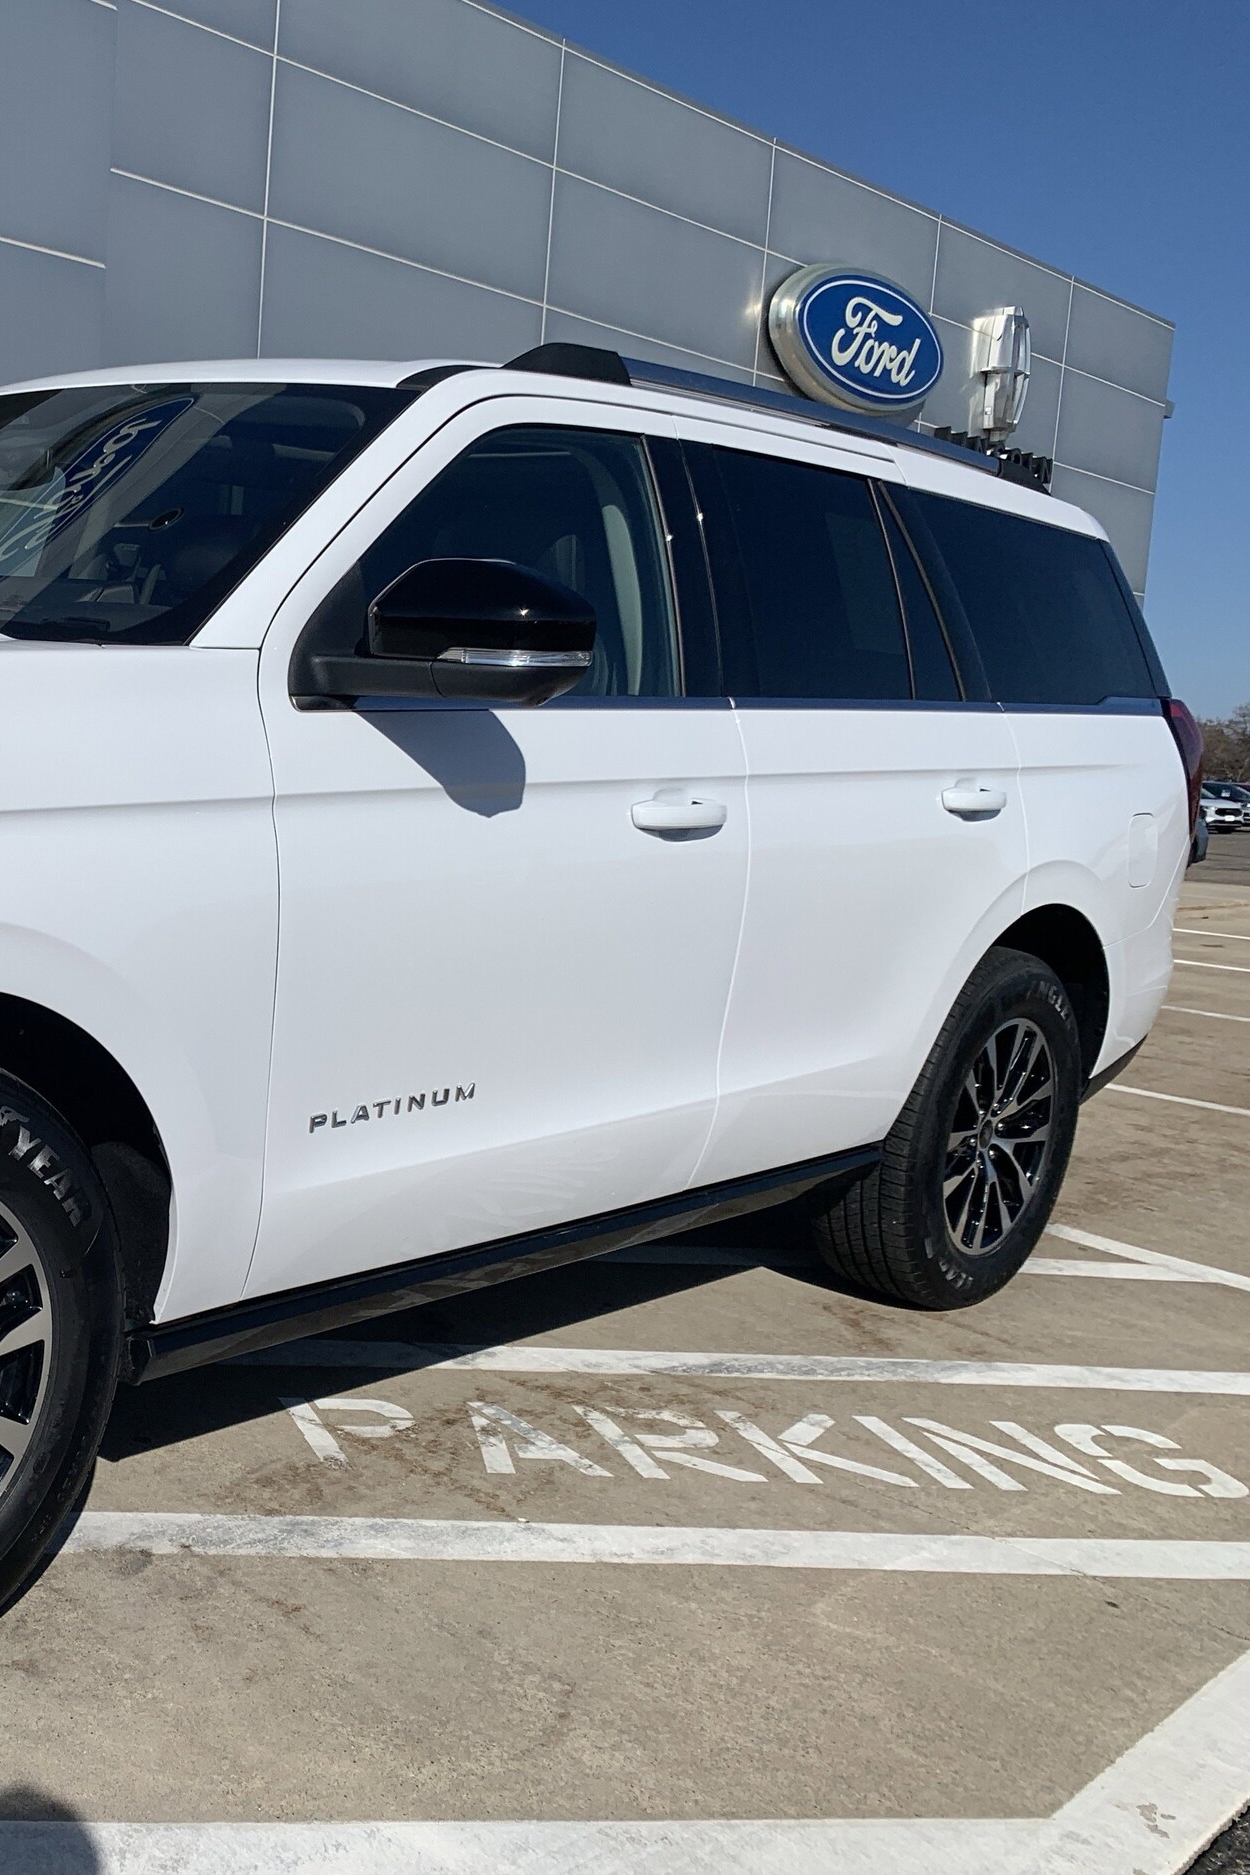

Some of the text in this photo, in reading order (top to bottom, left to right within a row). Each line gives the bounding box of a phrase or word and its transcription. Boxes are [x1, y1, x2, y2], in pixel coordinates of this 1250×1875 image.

[831, 296, 922, 387] Ford
[308, 1082, 476, 1134] PLATINUM
[278, 1397, 1249, 1499] PARKING
